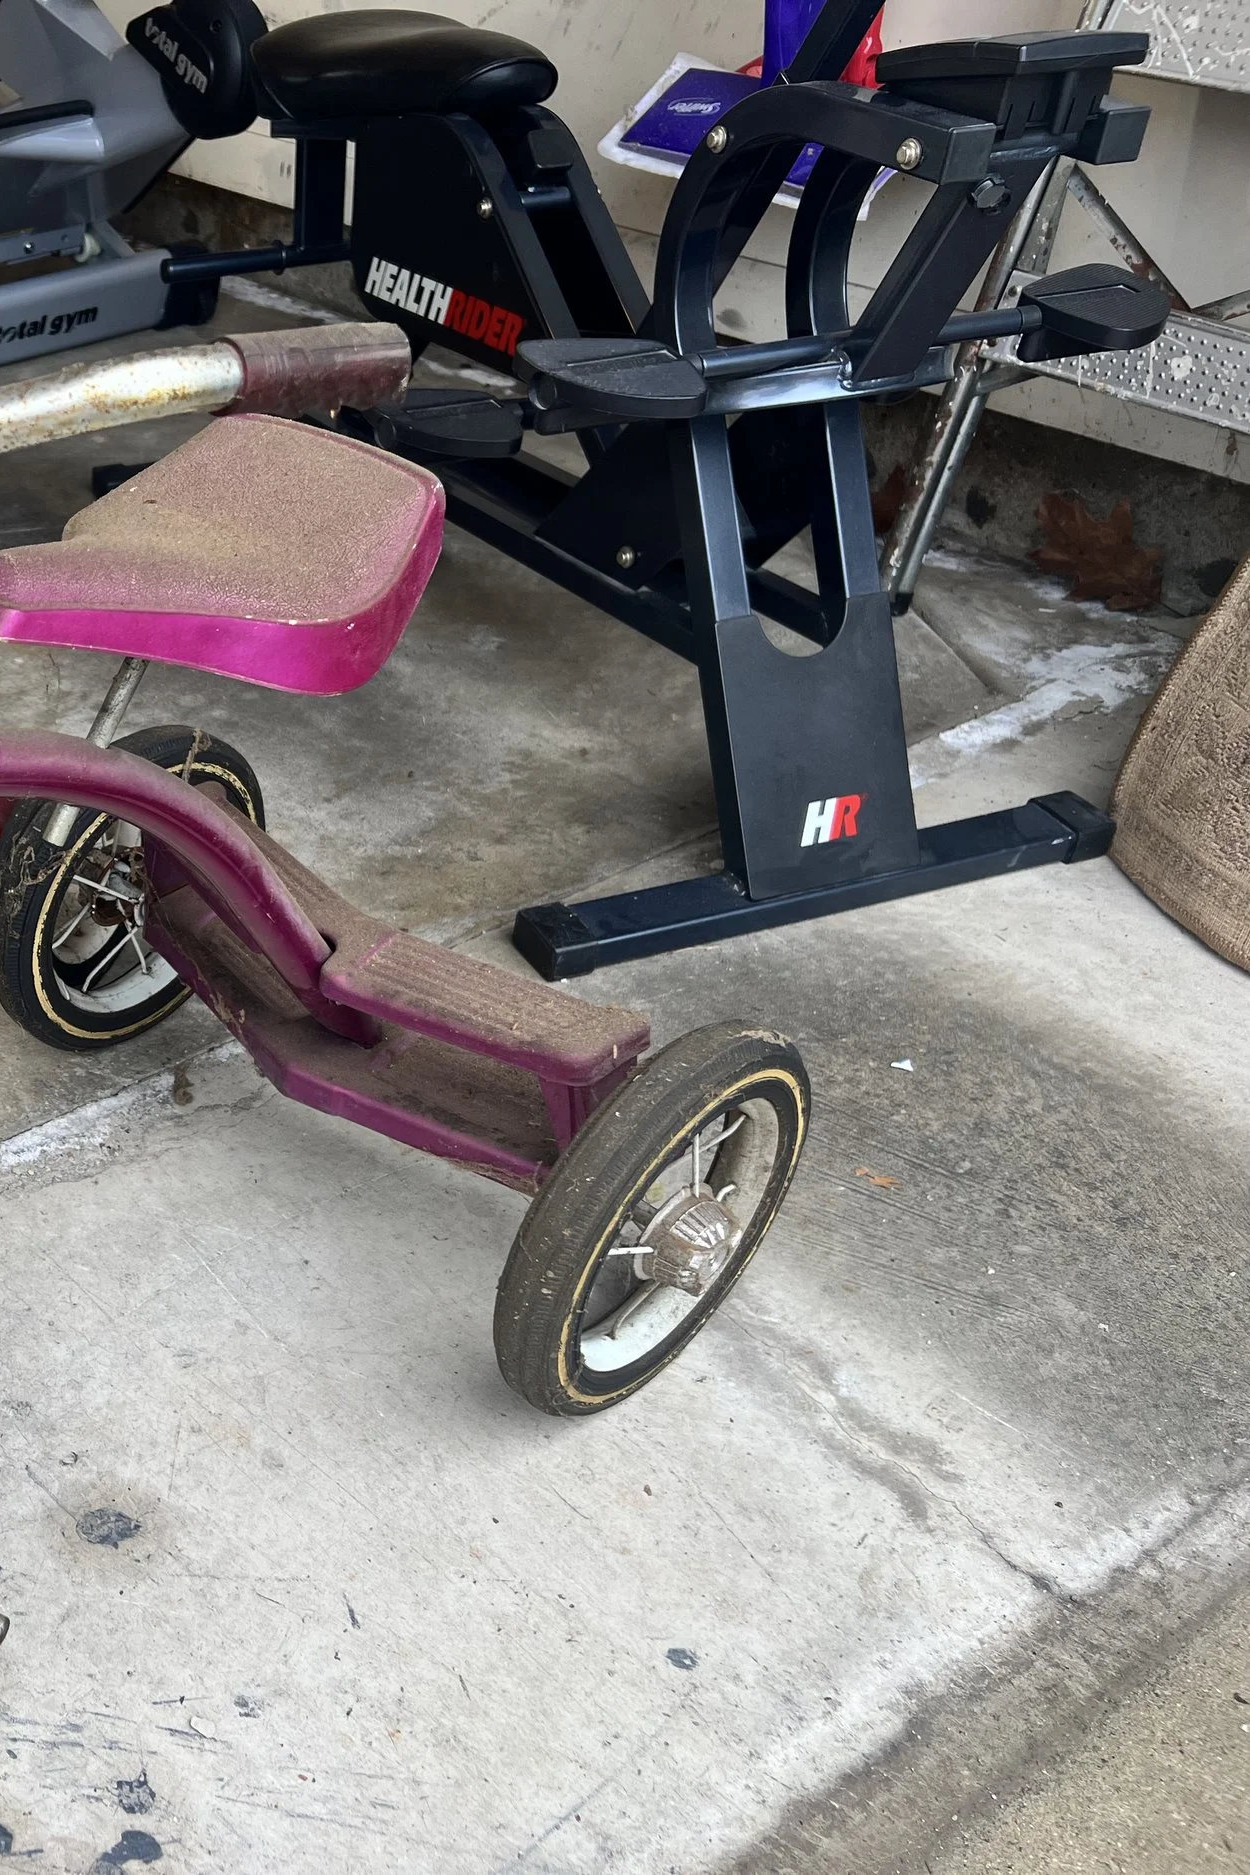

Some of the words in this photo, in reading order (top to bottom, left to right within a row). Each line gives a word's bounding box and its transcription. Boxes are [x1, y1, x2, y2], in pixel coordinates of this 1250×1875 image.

[145, 17, 179, 63] total
[175, 53, 208, 94] gym
[48, 306, 99, 335] gym
[364, 256, 525, 357] HEALTHRIDER
[800, 794, 861, 848] HR
